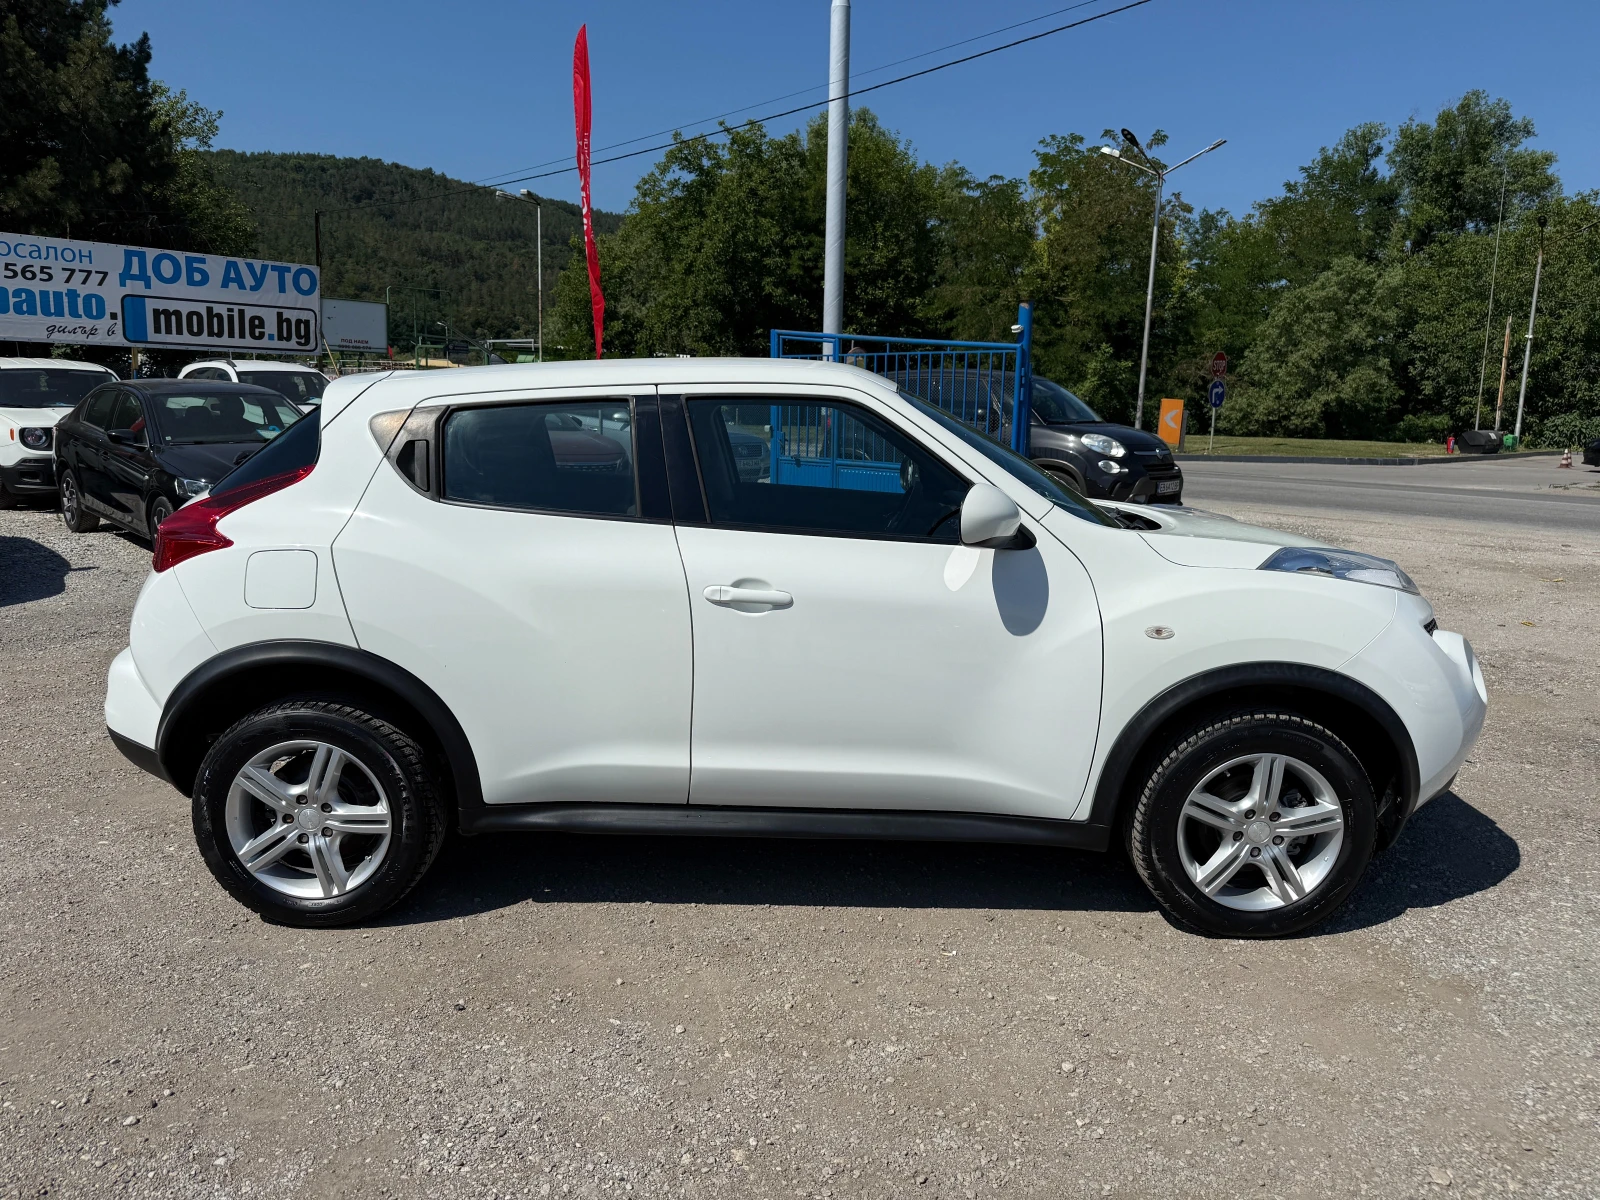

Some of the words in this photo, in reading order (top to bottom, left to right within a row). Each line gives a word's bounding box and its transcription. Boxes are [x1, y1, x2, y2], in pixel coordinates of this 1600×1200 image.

[0, 240, 93, 264] осалон
[3, 262, 54, 282] 565
[61, 267, 109, 287] 777
[118, 248, 210, 290] ДОБ
[220, 260, 318, 297] АУТО
[45, 324, 100, 339] дилър
[152, 305, 311, 347] mobile.bg
[1212, 360, 1226, 371] STOP
